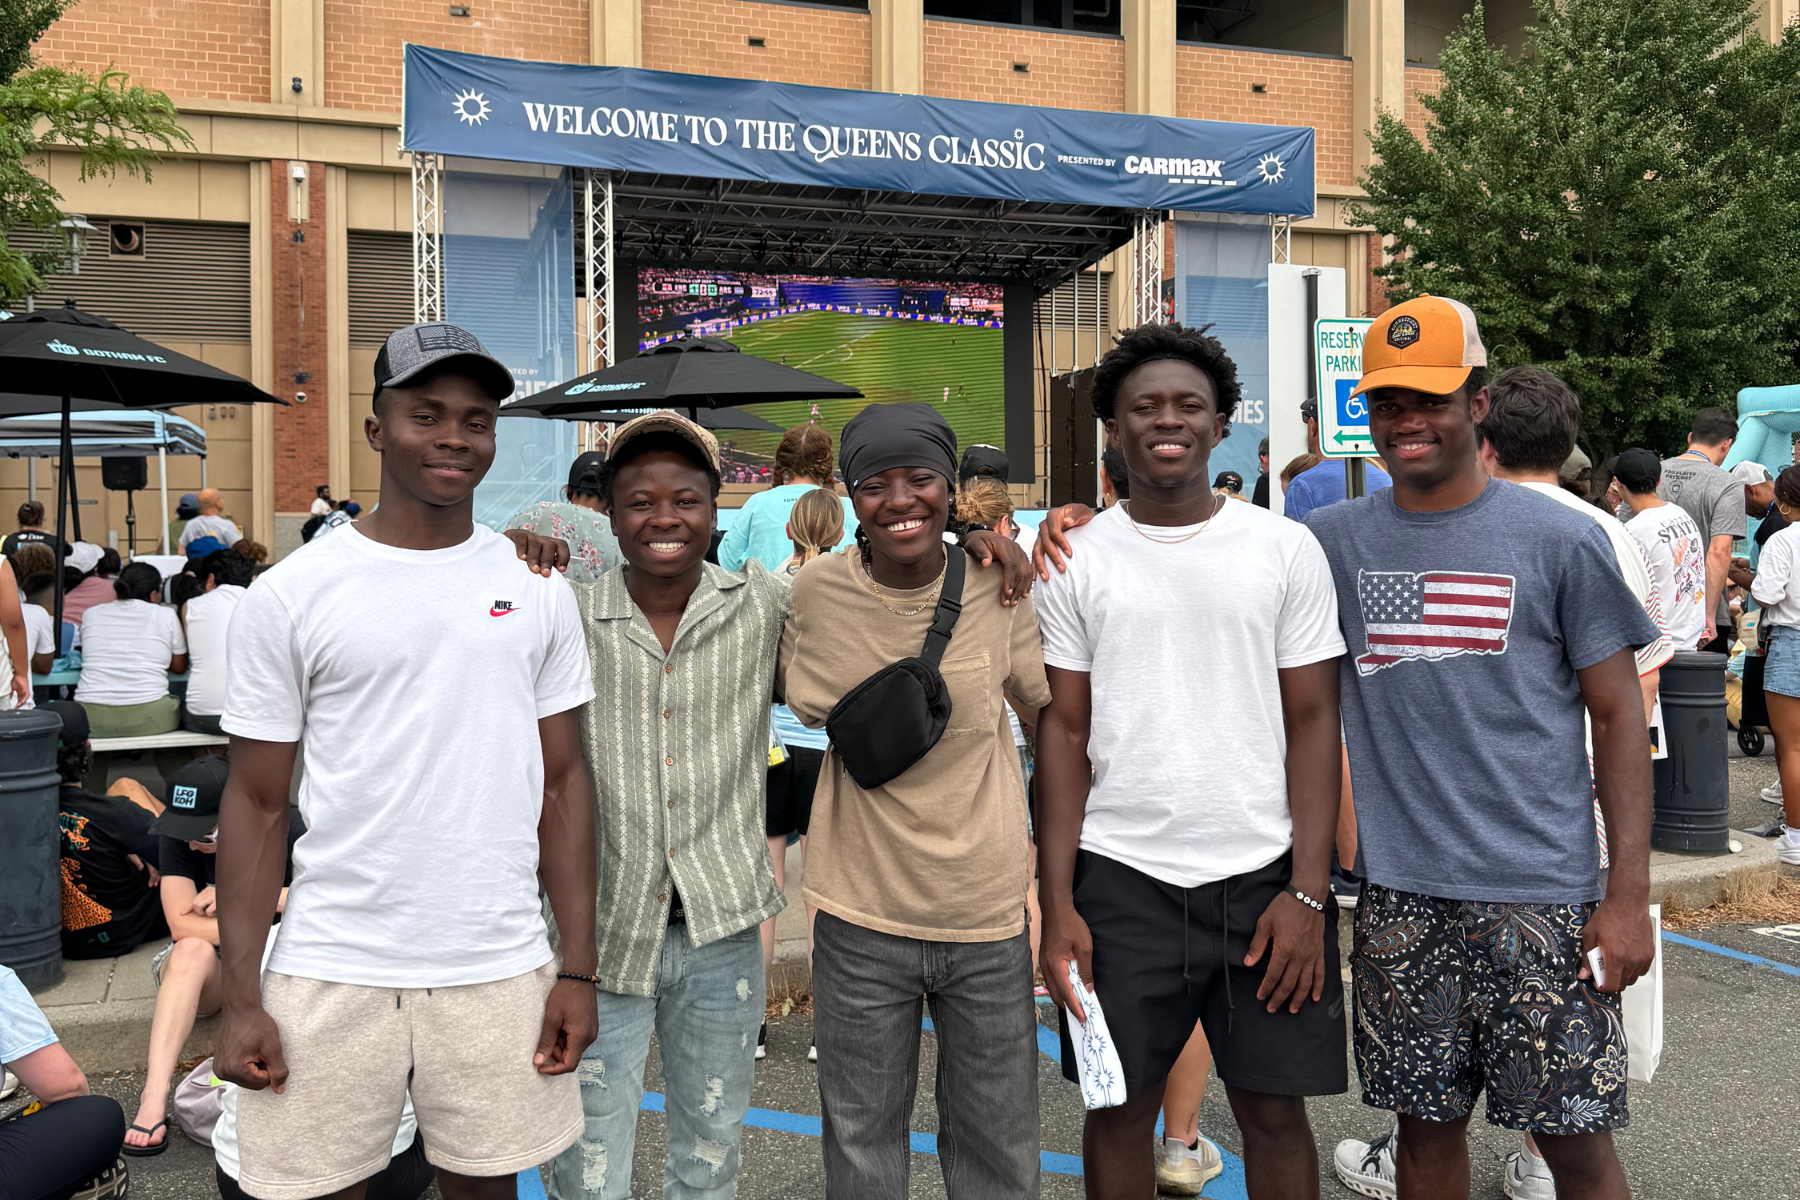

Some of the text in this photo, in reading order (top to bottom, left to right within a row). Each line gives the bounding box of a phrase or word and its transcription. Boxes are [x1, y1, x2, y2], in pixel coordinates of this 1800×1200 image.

[522, 102, 1045, 171] WELCOME TO THE QUEENS CLASSIC
[1057, 155, 1116, 167] PRESENTED BY
[1320, 332, 1366, 348] RESERV
[83, 348, 167, 364] GOTHAM FC
[1326, 355, 1361, 372] PARKI
[494, 600, 513, 610] NIKE
[176, 789, 195, 798] LFG
[174, 796, 194, 806] KOH
